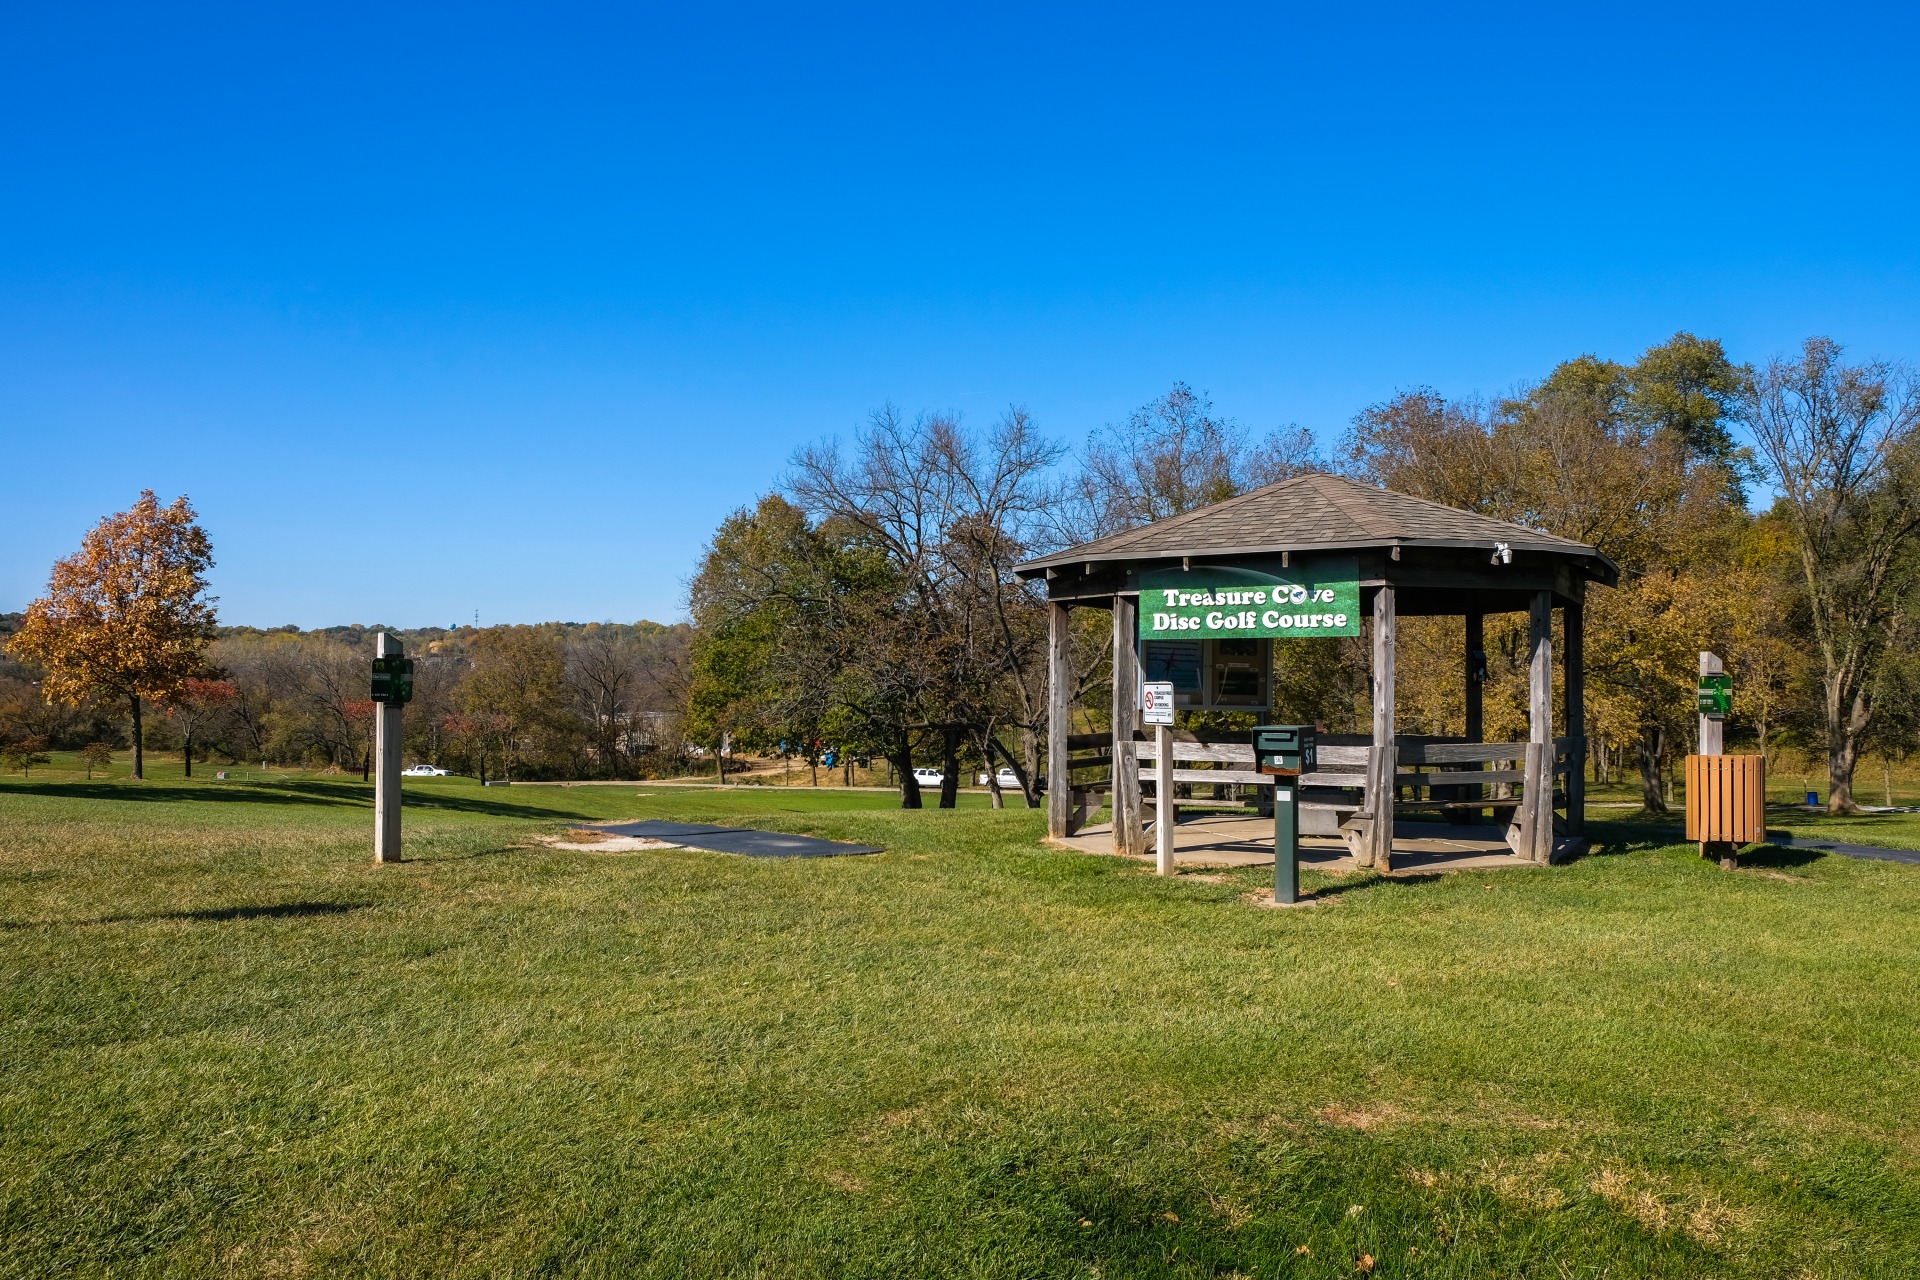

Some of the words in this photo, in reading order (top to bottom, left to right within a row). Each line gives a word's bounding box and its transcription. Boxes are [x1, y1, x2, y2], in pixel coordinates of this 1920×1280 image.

[1163, 588, 1266, 607] Treasure
[1271, 584, 1335, 604] Cove
[1152, 613, 1201, 631] Disc
[1205, 611, 1257, 630] Golf
[1261, 610, 1348, 629] Course
[1305, 748, 1313, 765] $1
